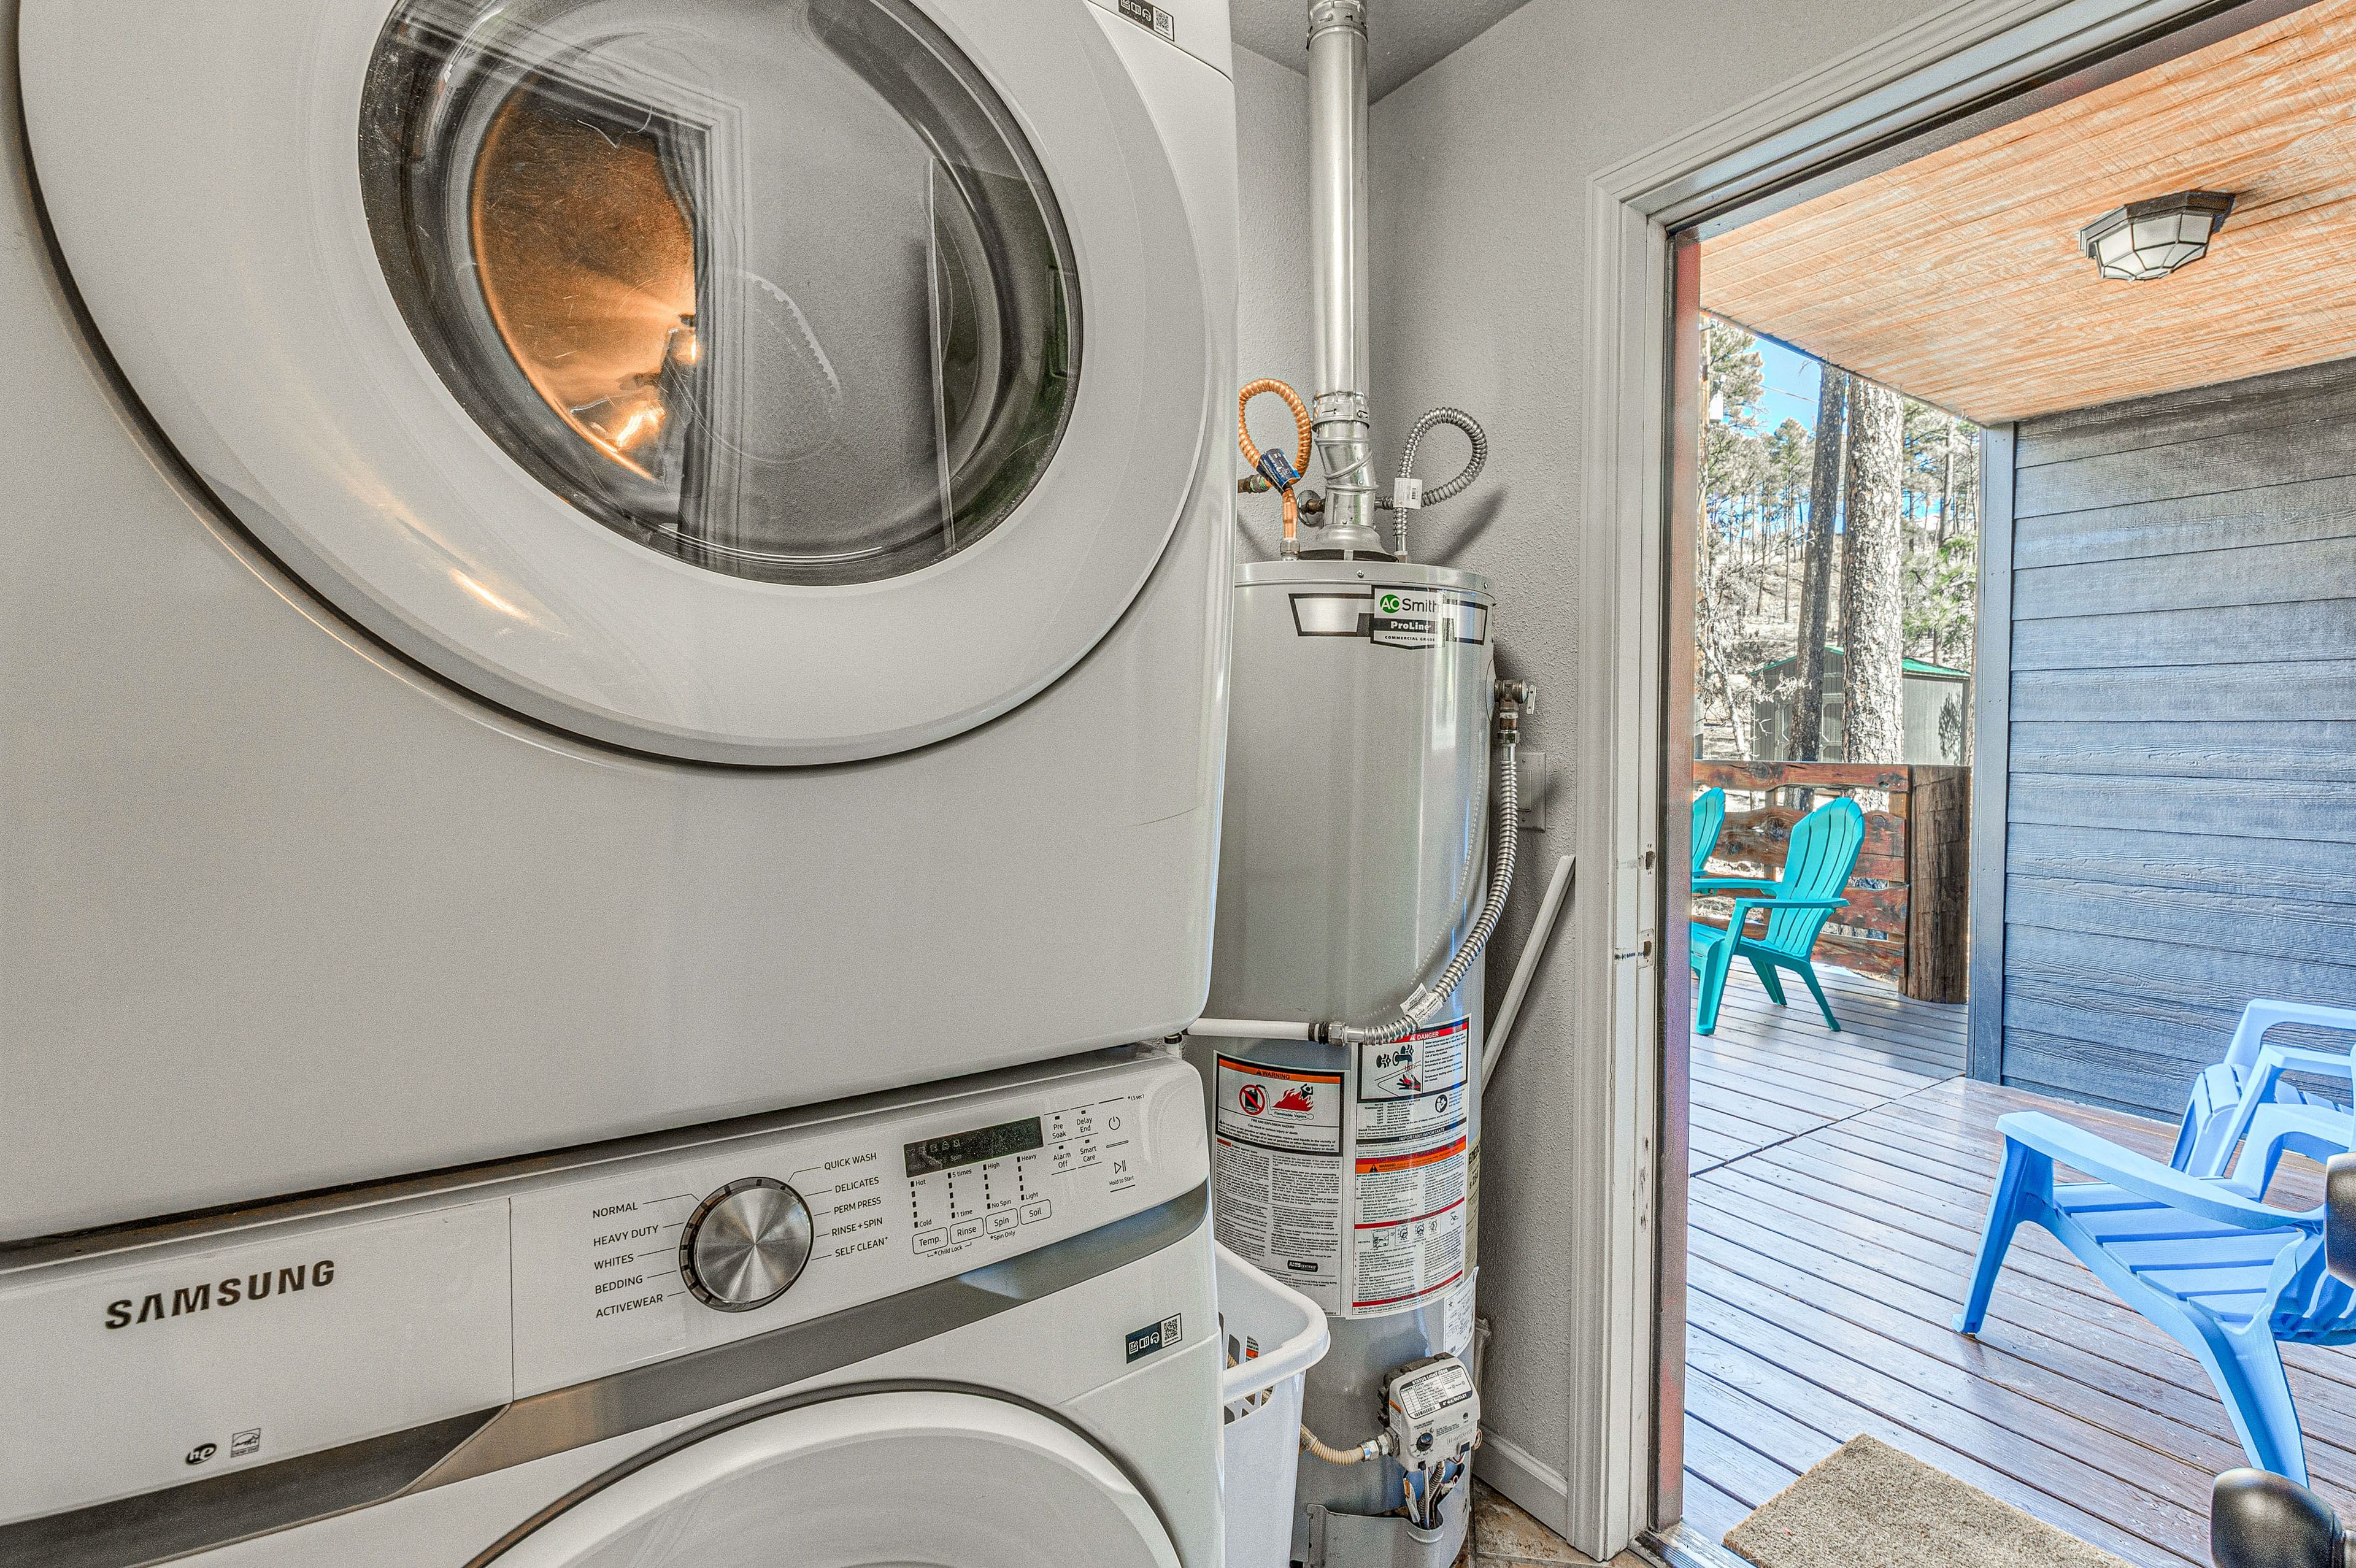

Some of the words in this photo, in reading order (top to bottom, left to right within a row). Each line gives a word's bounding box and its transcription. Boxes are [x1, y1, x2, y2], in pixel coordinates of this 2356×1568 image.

[1390, 621, 1430, 631] ProLine
[1417, 1032, 1439, 1040] DANGER
[1263, 1070, 1290, 1080] WARNING
[1076, 1117, 1093, 1126] Delay
[1052, 1131, 1066, 1139] Soak
[1080, 1146, 1096, 1155] Smart
[825, 1158, 850, 1170] QUICK
[852, 1153, 877, 1164] WASH
[1021, 1153, 1037, 1163] Heavy
[1053, 1152, 1071, 1161] Alarm
[1058, 1160, 1068, 1169] Off
[835, 1177, 879, 1193] DELICATES
[593, 1202, 638, 1218] NORMAL
[834, 1202, 856, 1214] PERM
[858, 1197, 882, 1209] PRESS
[1029, 1207, 1042, 1218] Soil
[832, 1223, 857, 1236] RINSE
[864, 1217, 883, 1229] SPIN
[994, 1217, 1009, 1228] Spin
[594, 1231, 628, 1247] HEAVY
[631, 1224, 658, 1238] DUTY
[957, 1226, 977, 1237] Rinse
[919, 1237, 941, 1247] Temp.
[835, 1245, 855, 1257] SELF
[594, 1253, 634, 1270] WHITES
[595, 1275, 643, 1294] BEDDING
[105, 1259, 335, 1329] SAMSUNG
[596, 1294, 663, 1318] ACTIVEWEAR
[1412, 1376, 1427, 1385] STATUS
